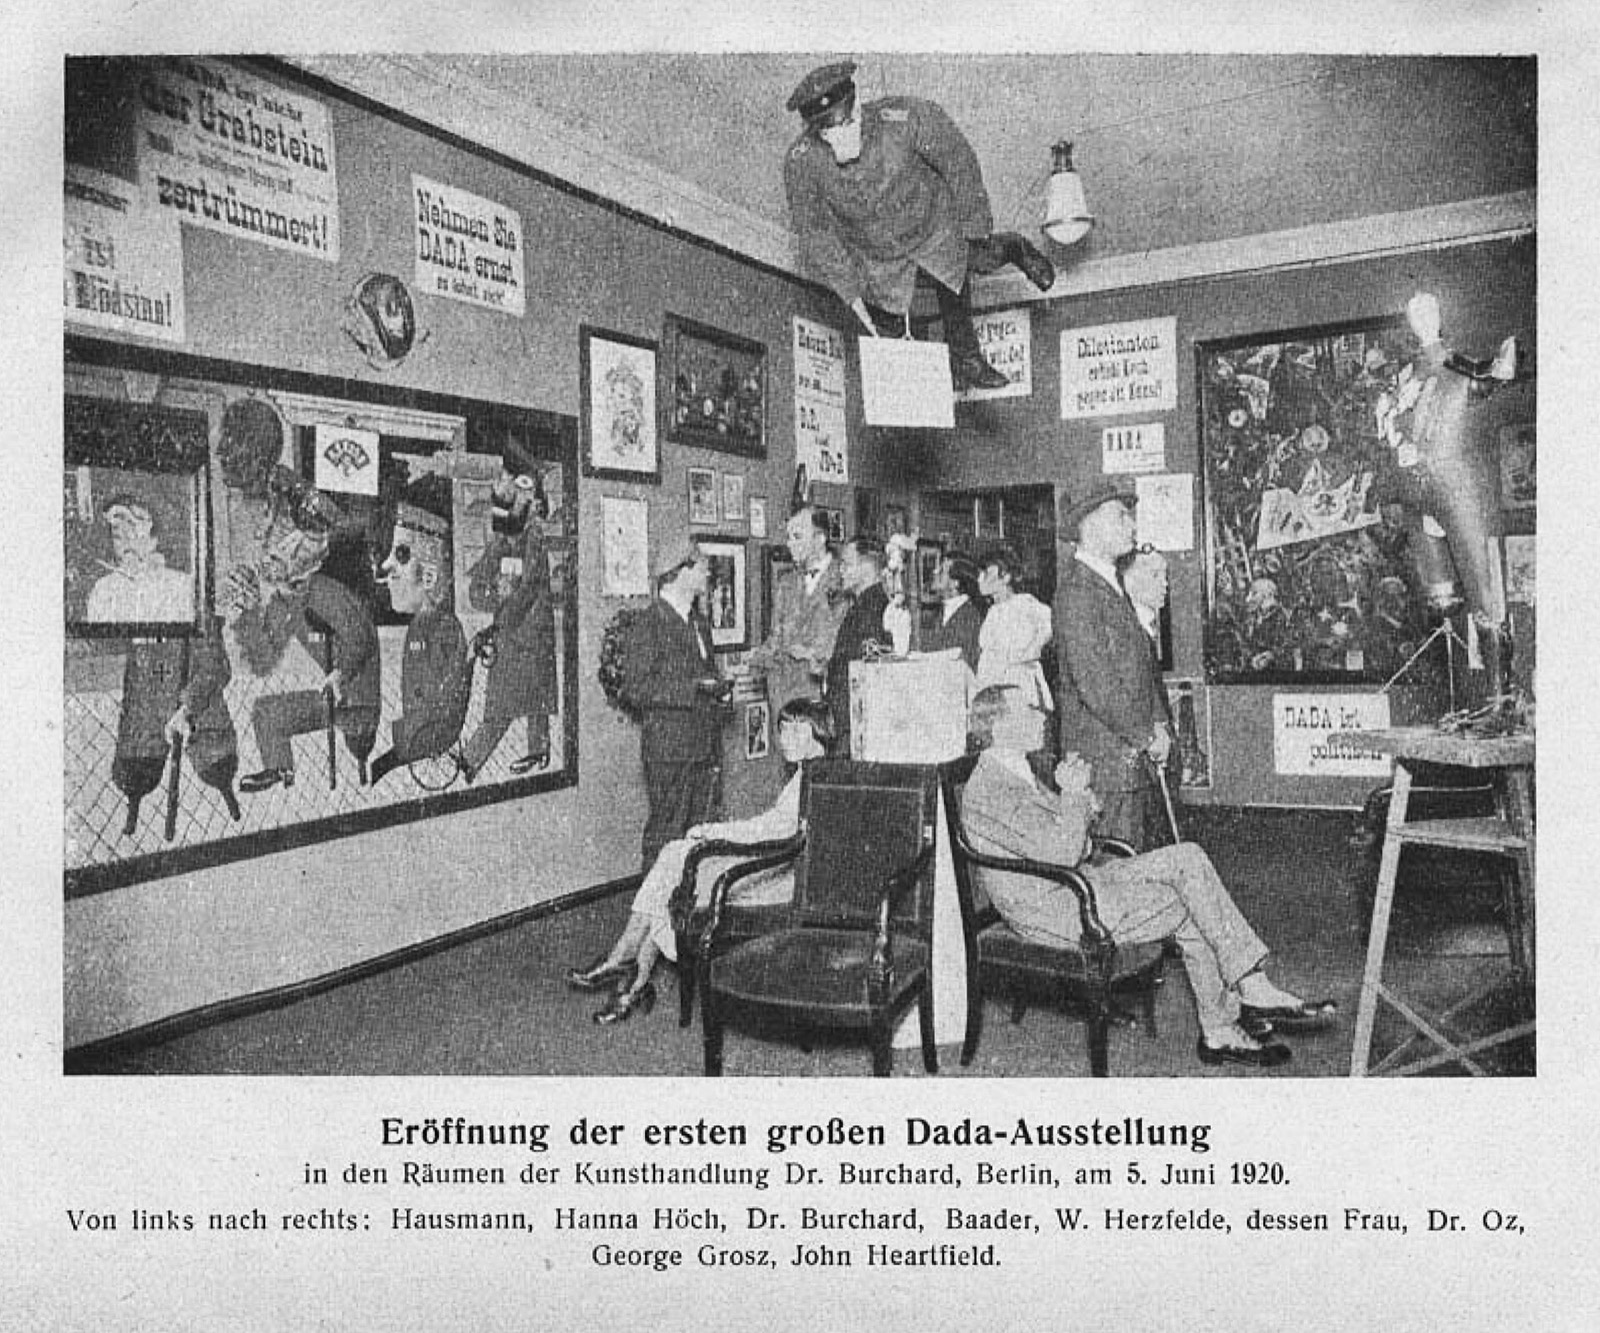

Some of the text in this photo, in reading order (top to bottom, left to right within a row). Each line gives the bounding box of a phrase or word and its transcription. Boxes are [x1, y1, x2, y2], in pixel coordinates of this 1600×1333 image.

[199, 91, 328, 173] Grabstein
[158, 175, 328, 251] zertrümmert!
[417, 188, 517, 252] Nehmen Sie
[419, 228, 470, 273] DADA
[1285, 706, 1332, 729] DADA
